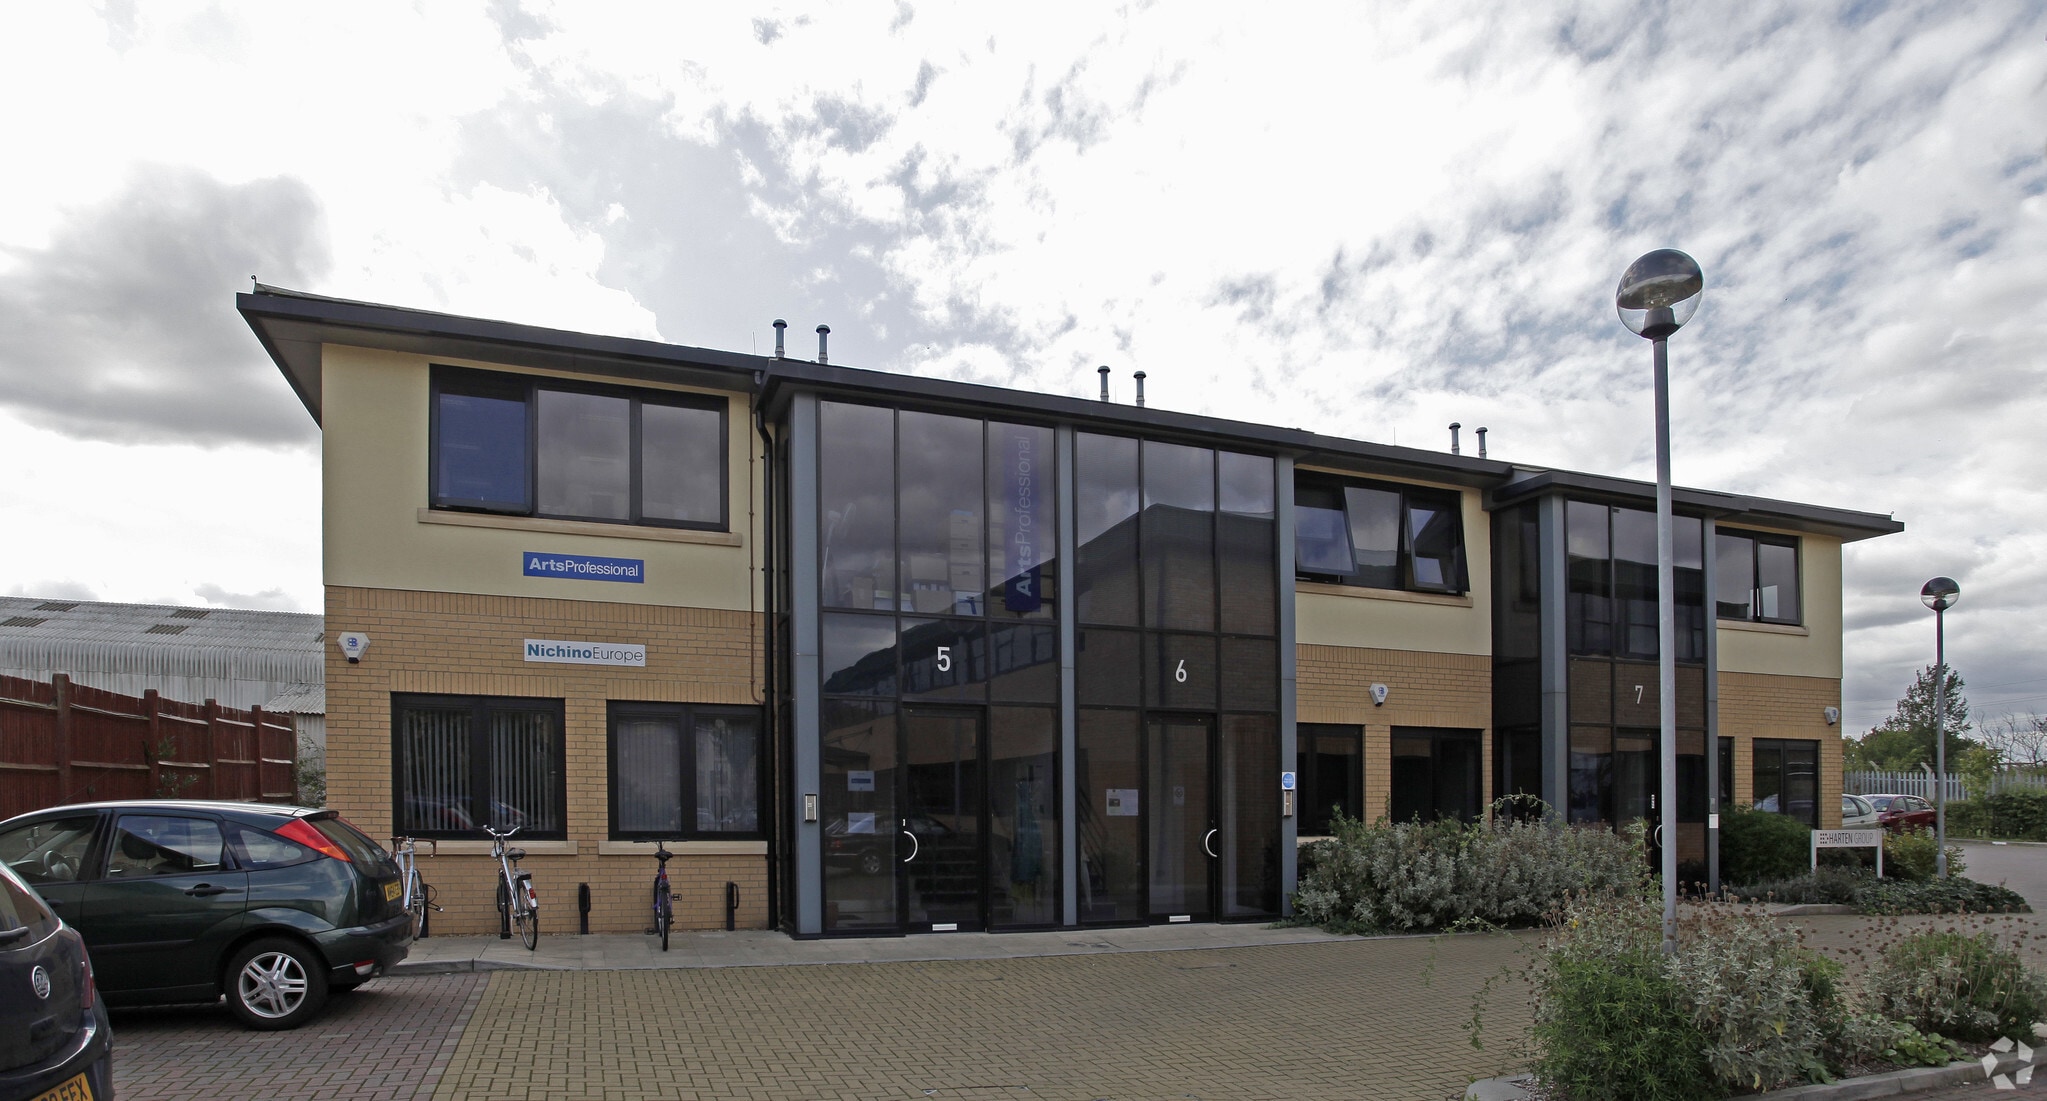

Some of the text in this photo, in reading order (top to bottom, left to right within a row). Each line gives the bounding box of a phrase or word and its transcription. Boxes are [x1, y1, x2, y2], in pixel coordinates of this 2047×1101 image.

[1015, 435, 1032, 597] ArtsProfessional
[529, 557, 639, 577] ArtsProfessional
[527, 644, 643, 664] NichinoEurope
[937, 646, 951, 672] 5
[1175, 660, 1187, 683] 6
[1634, 685, 1644, 704] 7
[1829, 832, 1874, 844] HARTEN GROUP
